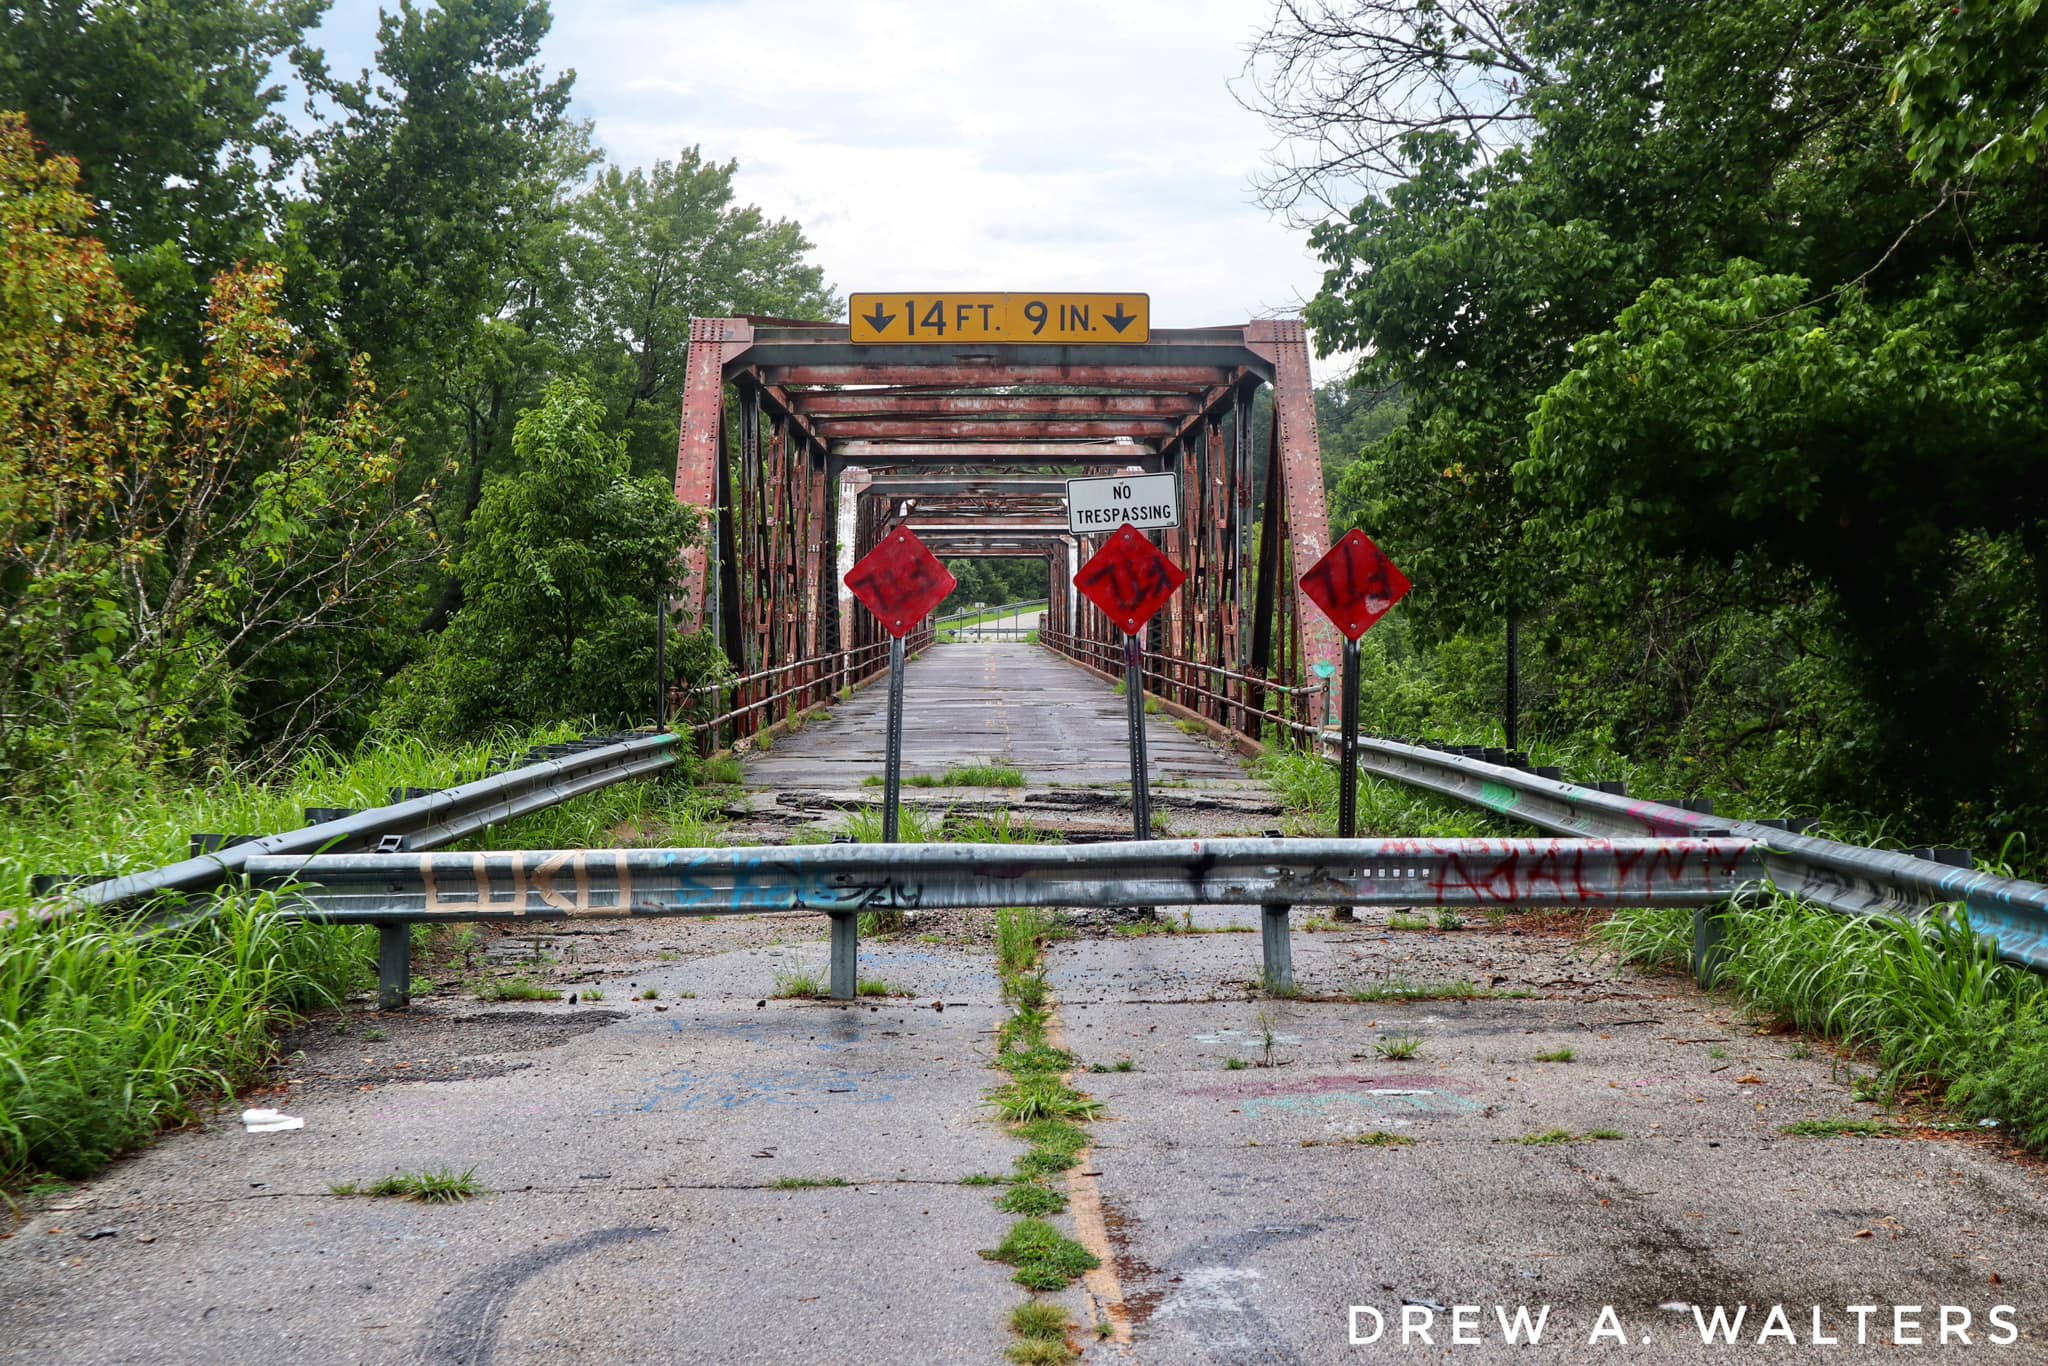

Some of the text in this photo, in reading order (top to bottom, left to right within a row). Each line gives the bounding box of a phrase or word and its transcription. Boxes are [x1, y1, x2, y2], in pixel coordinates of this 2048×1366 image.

[905, 300, 1097, 336] 14 FT. 9 IN.
[1113, 485, 1131, 499] NO
[1076, 504, 1171, 524] TRESPASSING
